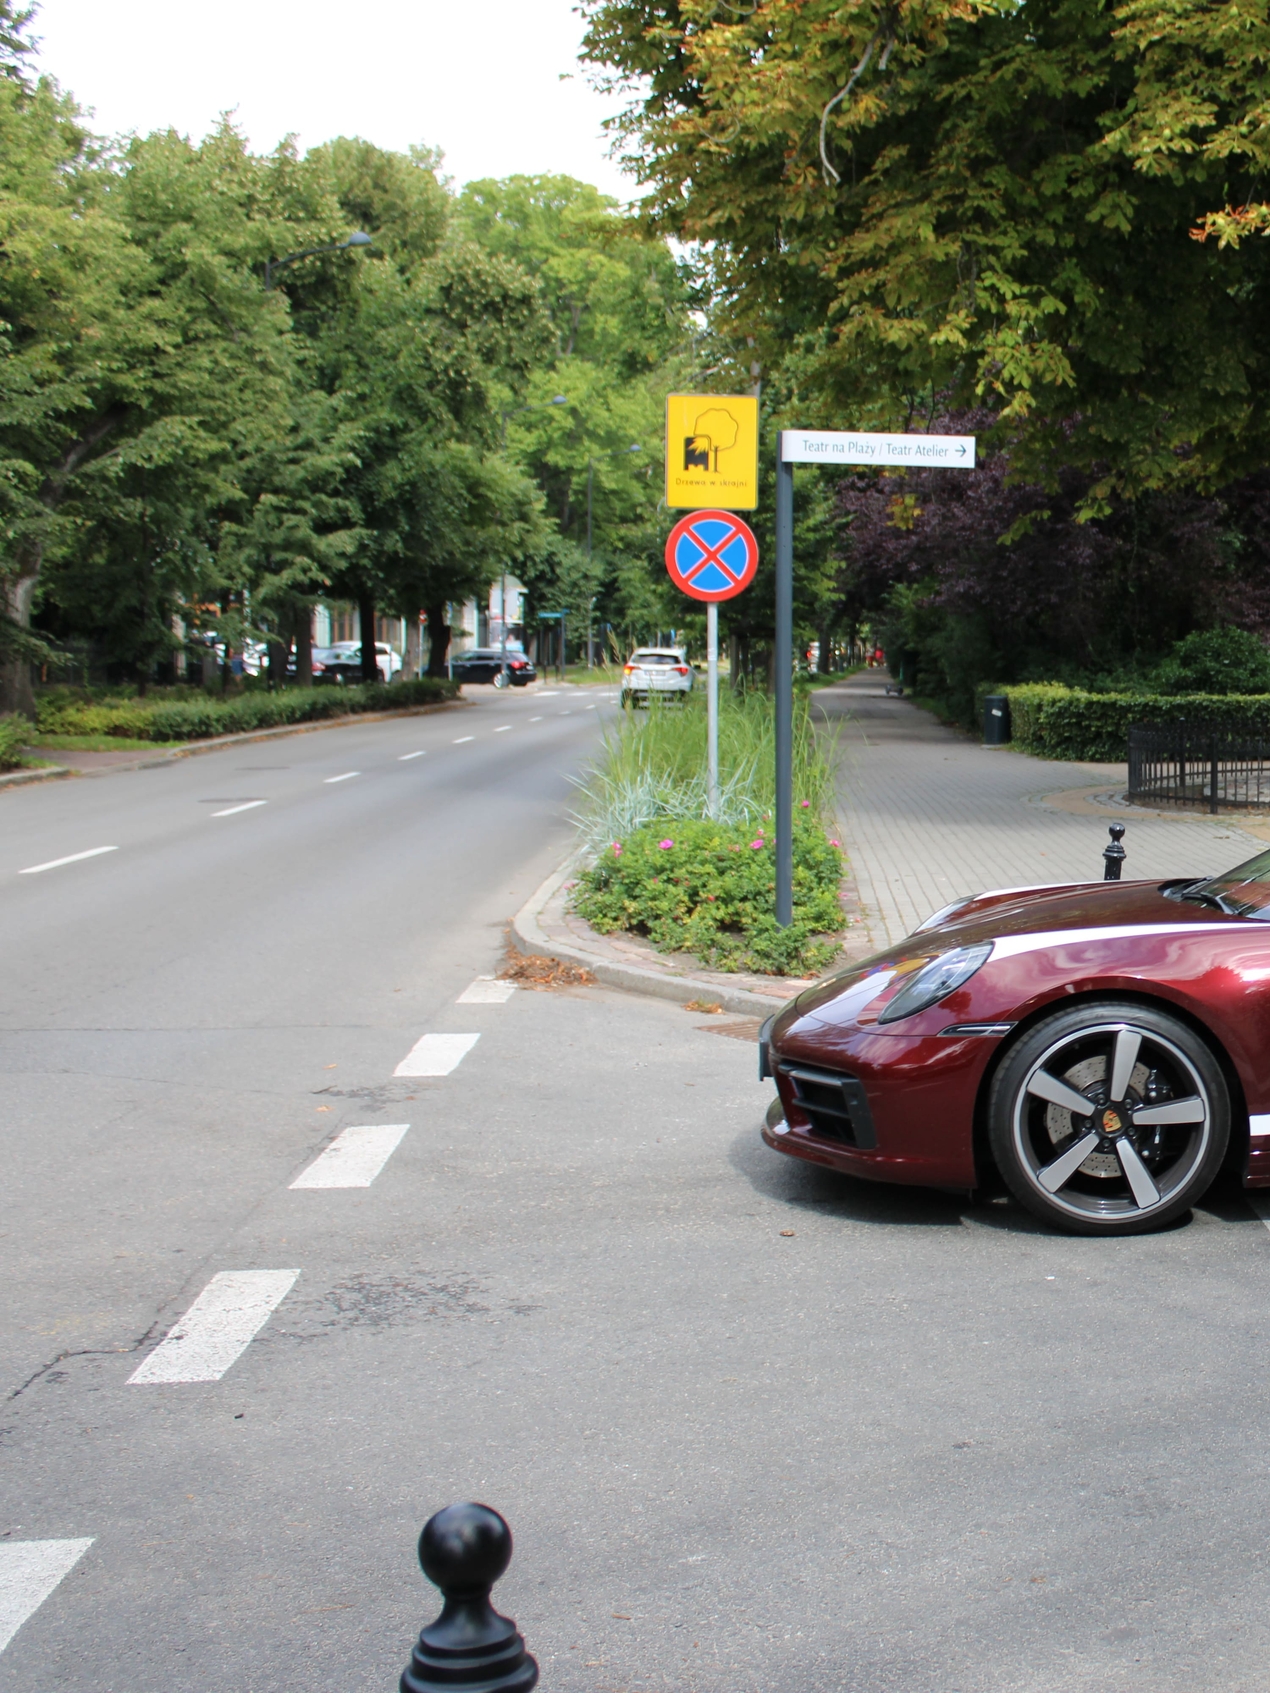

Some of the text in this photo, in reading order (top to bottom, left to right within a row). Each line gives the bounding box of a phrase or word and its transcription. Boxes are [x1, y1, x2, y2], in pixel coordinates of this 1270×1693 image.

[803, 439, 829, 453] Teatr
[832, 444, 845, 454] na
[848, 441, 876, 457] Plaży
[886, 443, 912, 456] Teatr
[914, 445, 949, 457] Atelier
[675, 477, 706, 487] Drzewa
[719, 478, 748, 489] skrajni
